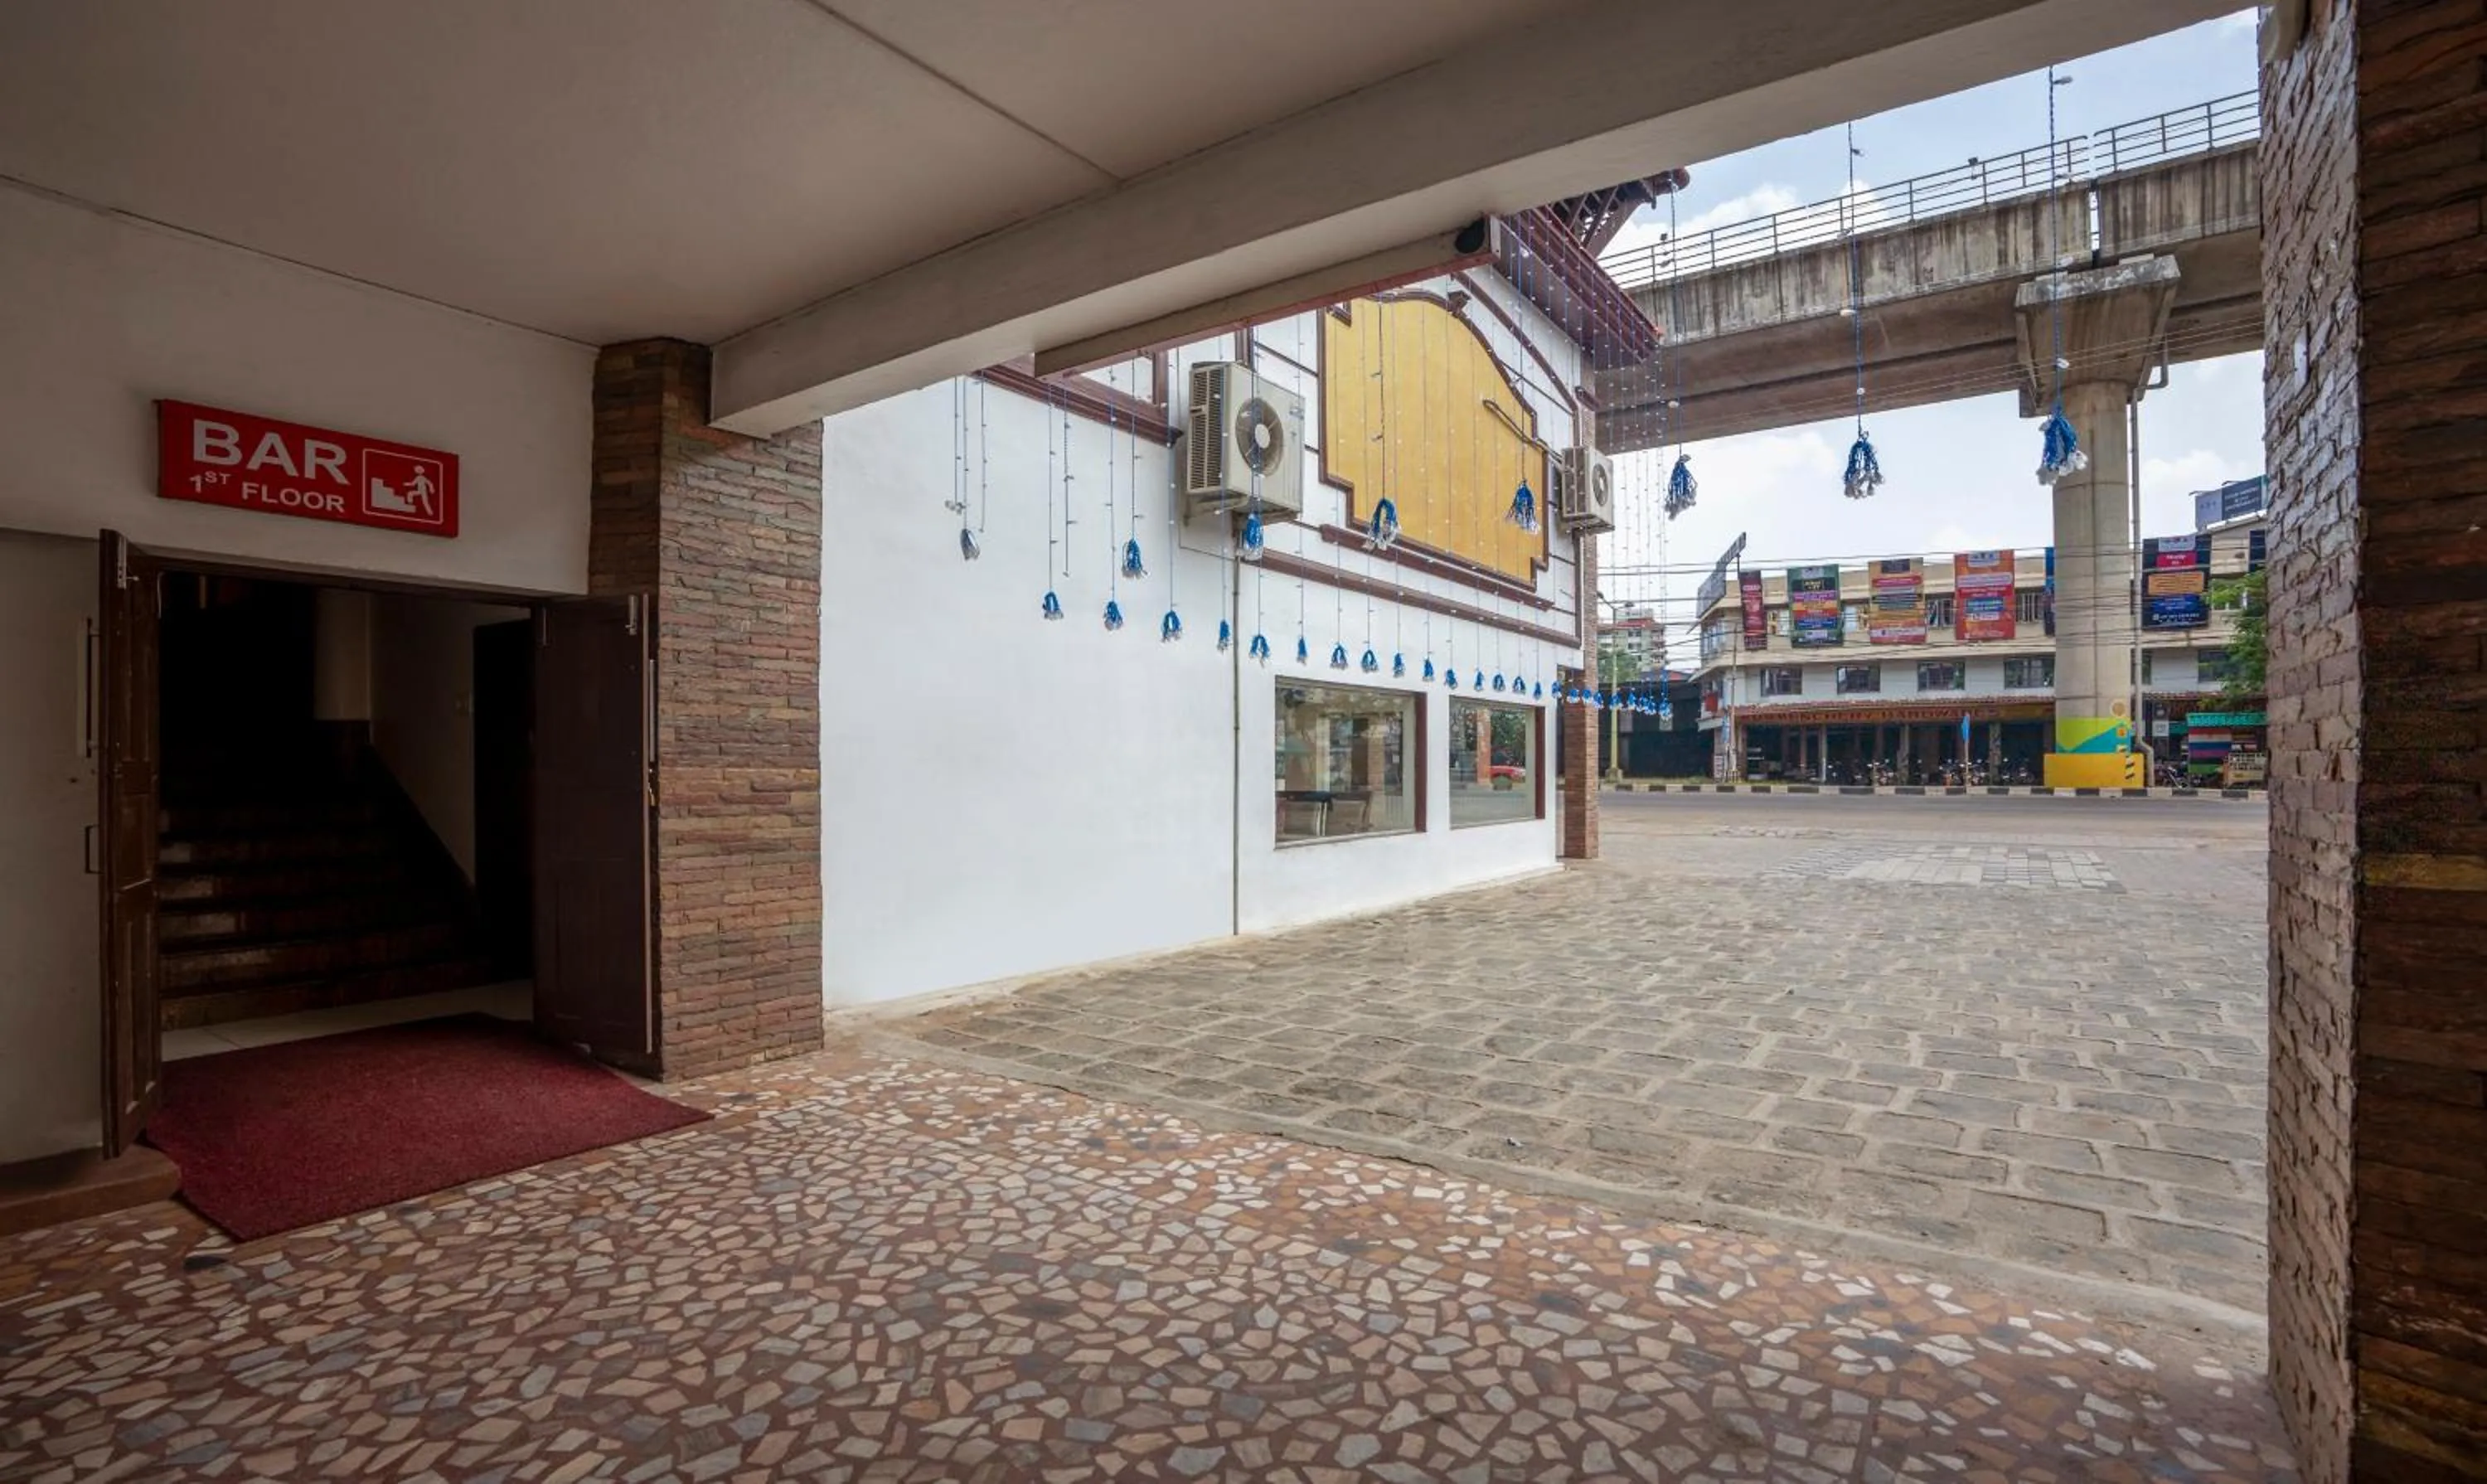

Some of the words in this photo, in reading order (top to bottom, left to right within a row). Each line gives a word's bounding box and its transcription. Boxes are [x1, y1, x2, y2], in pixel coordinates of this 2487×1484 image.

[192, 418, 351, 485] BAR
[190, 470, 231, 493] 1ST
[241, 482, 345, 513] FLOOR
